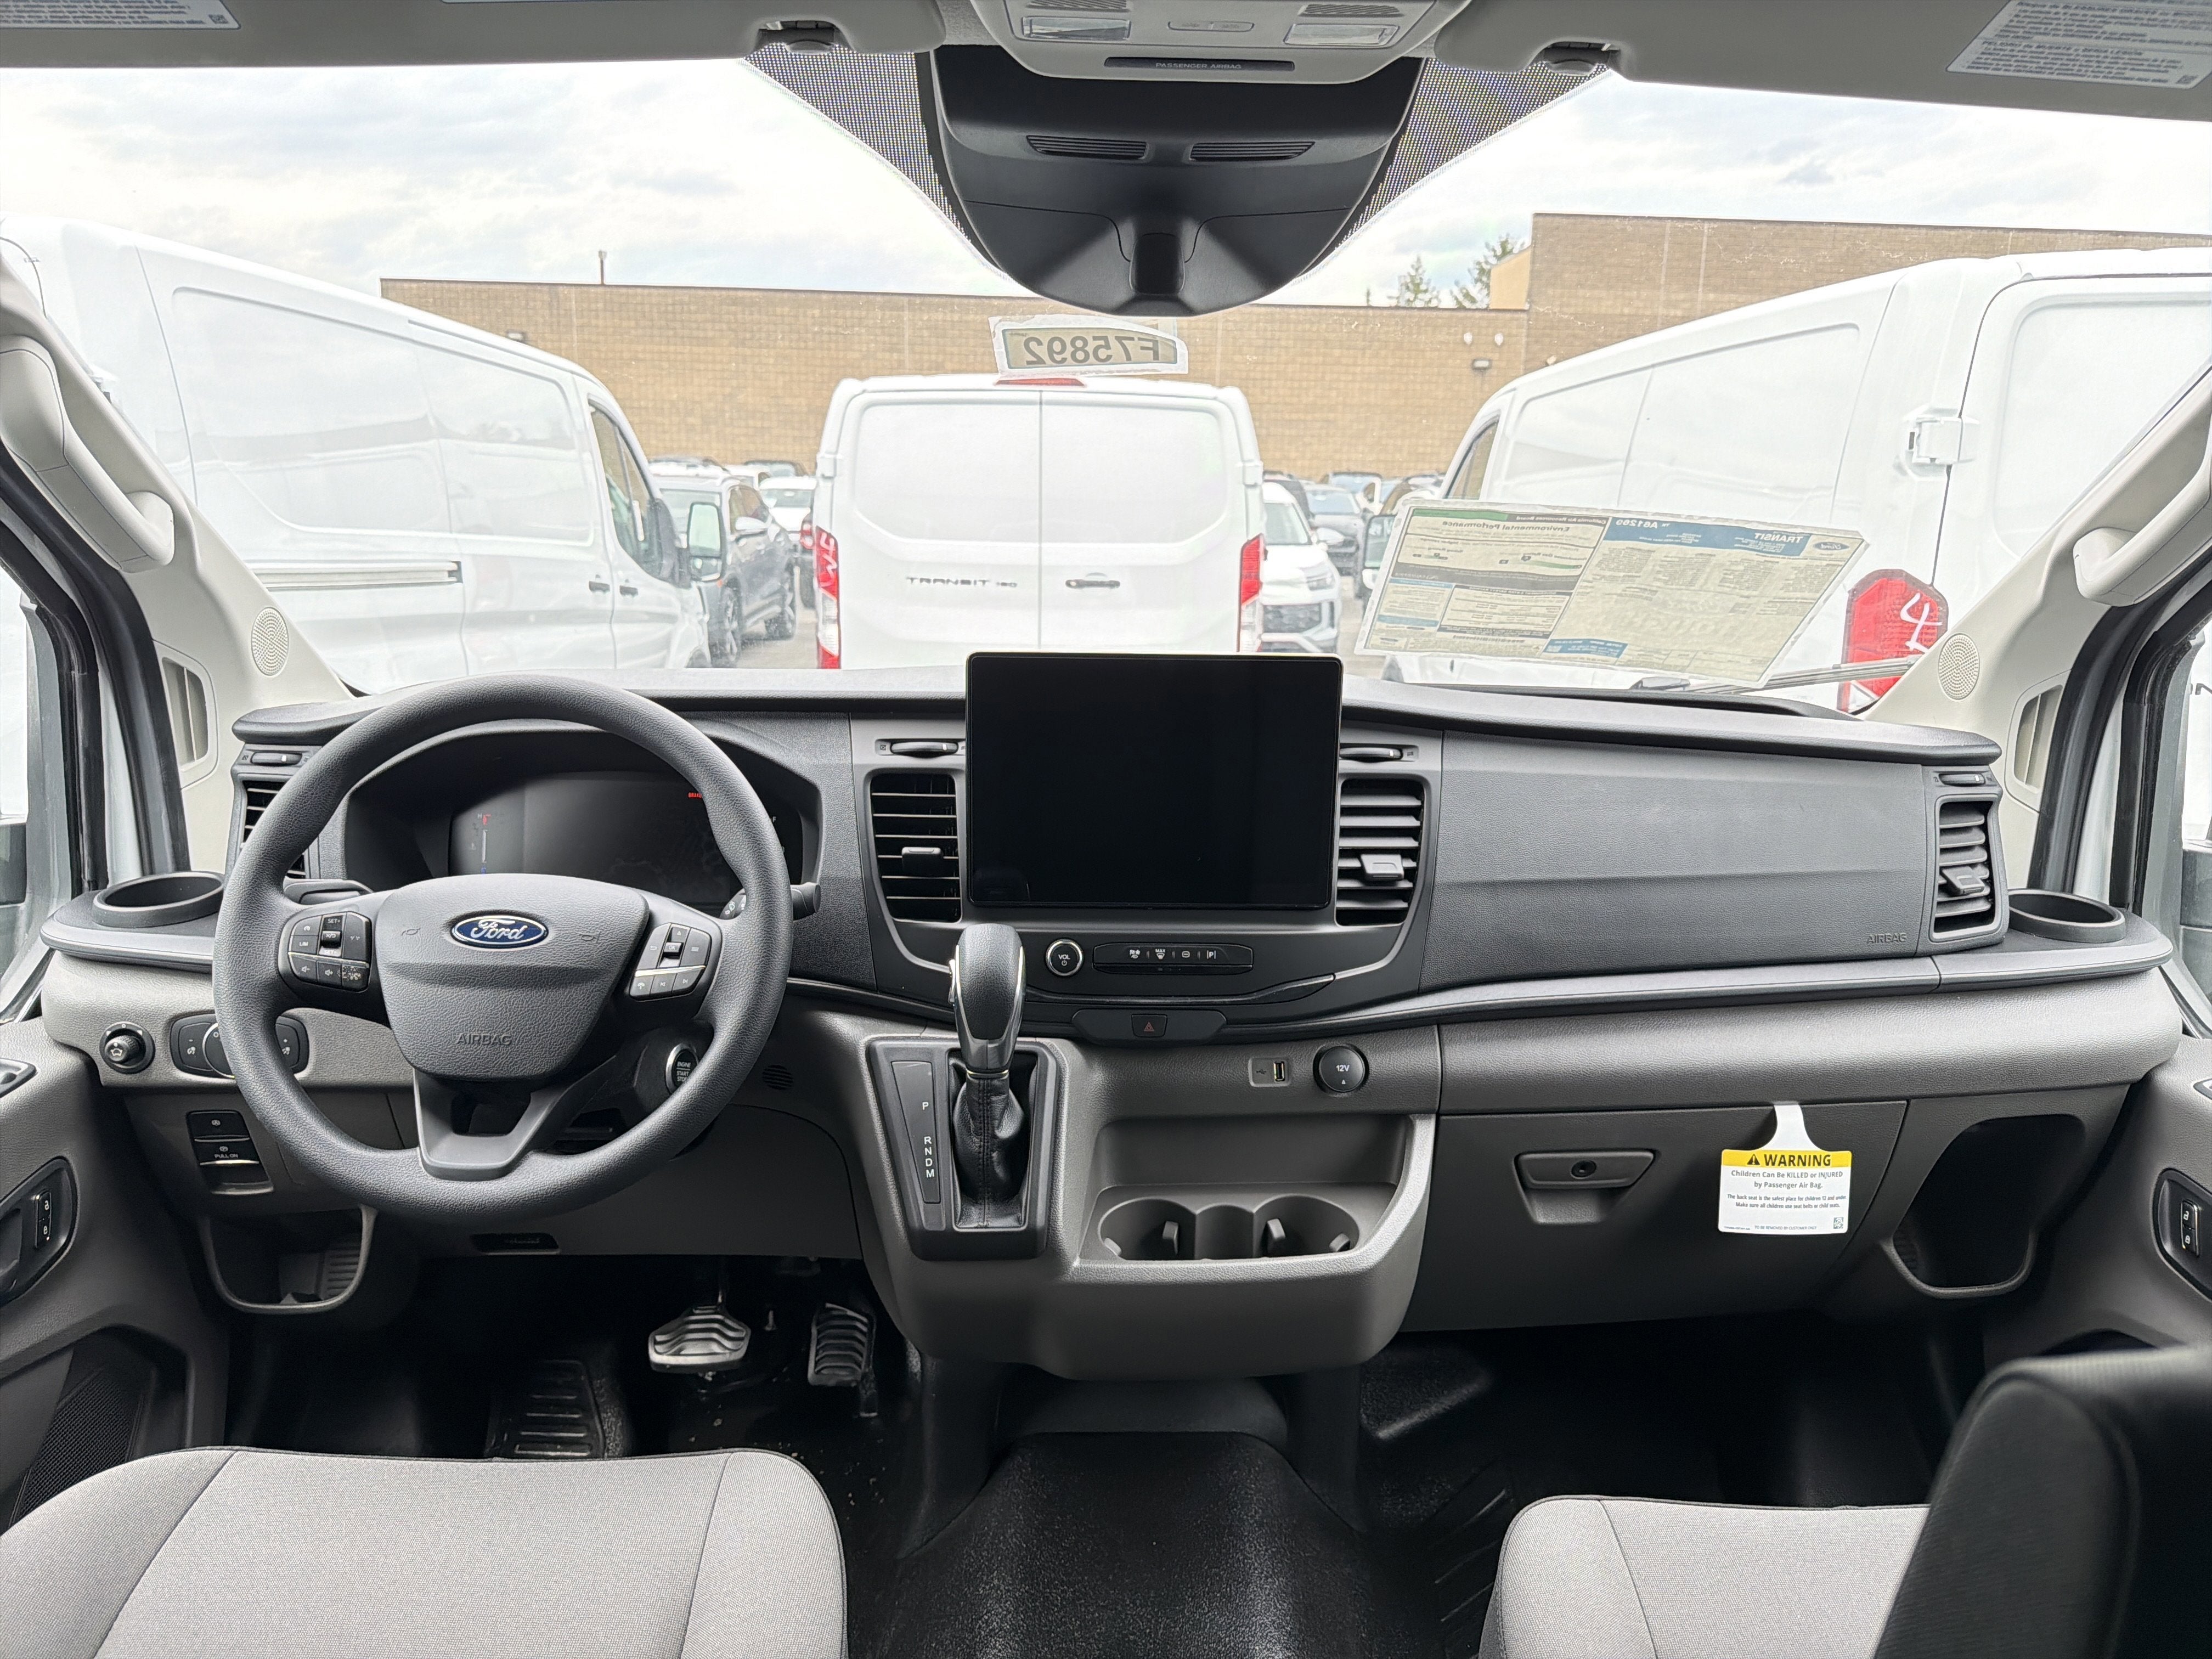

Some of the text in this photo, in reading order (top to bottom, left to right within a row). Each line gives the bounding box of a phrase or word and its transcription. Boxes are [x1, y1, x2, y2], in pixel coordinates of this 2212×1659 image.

[1900, 592, 1943, 653] 4
[470, 919, 526, 939] Ford
[1866, 932, 1908, 944] AIRBAG
[457, 1033, 512, 1046] AIRBAG
[1335, 1064, 1350, 1073] 12V
[922, 1102, 929, 1110] P
[924, 1136, 932, 1144] R
[925, 1147, 932, 1156] N
[926, 1158, 933, 1167] D
[1764, 1154, 1831, 1167] WARNING
[926, 1169, 935, 1178] M
[1819, 1171, 1843, 1180] INJURED
[1764, 1181, 1798, 1190] Passenger
[1809, 1182, 1823, 1190] Bag.
